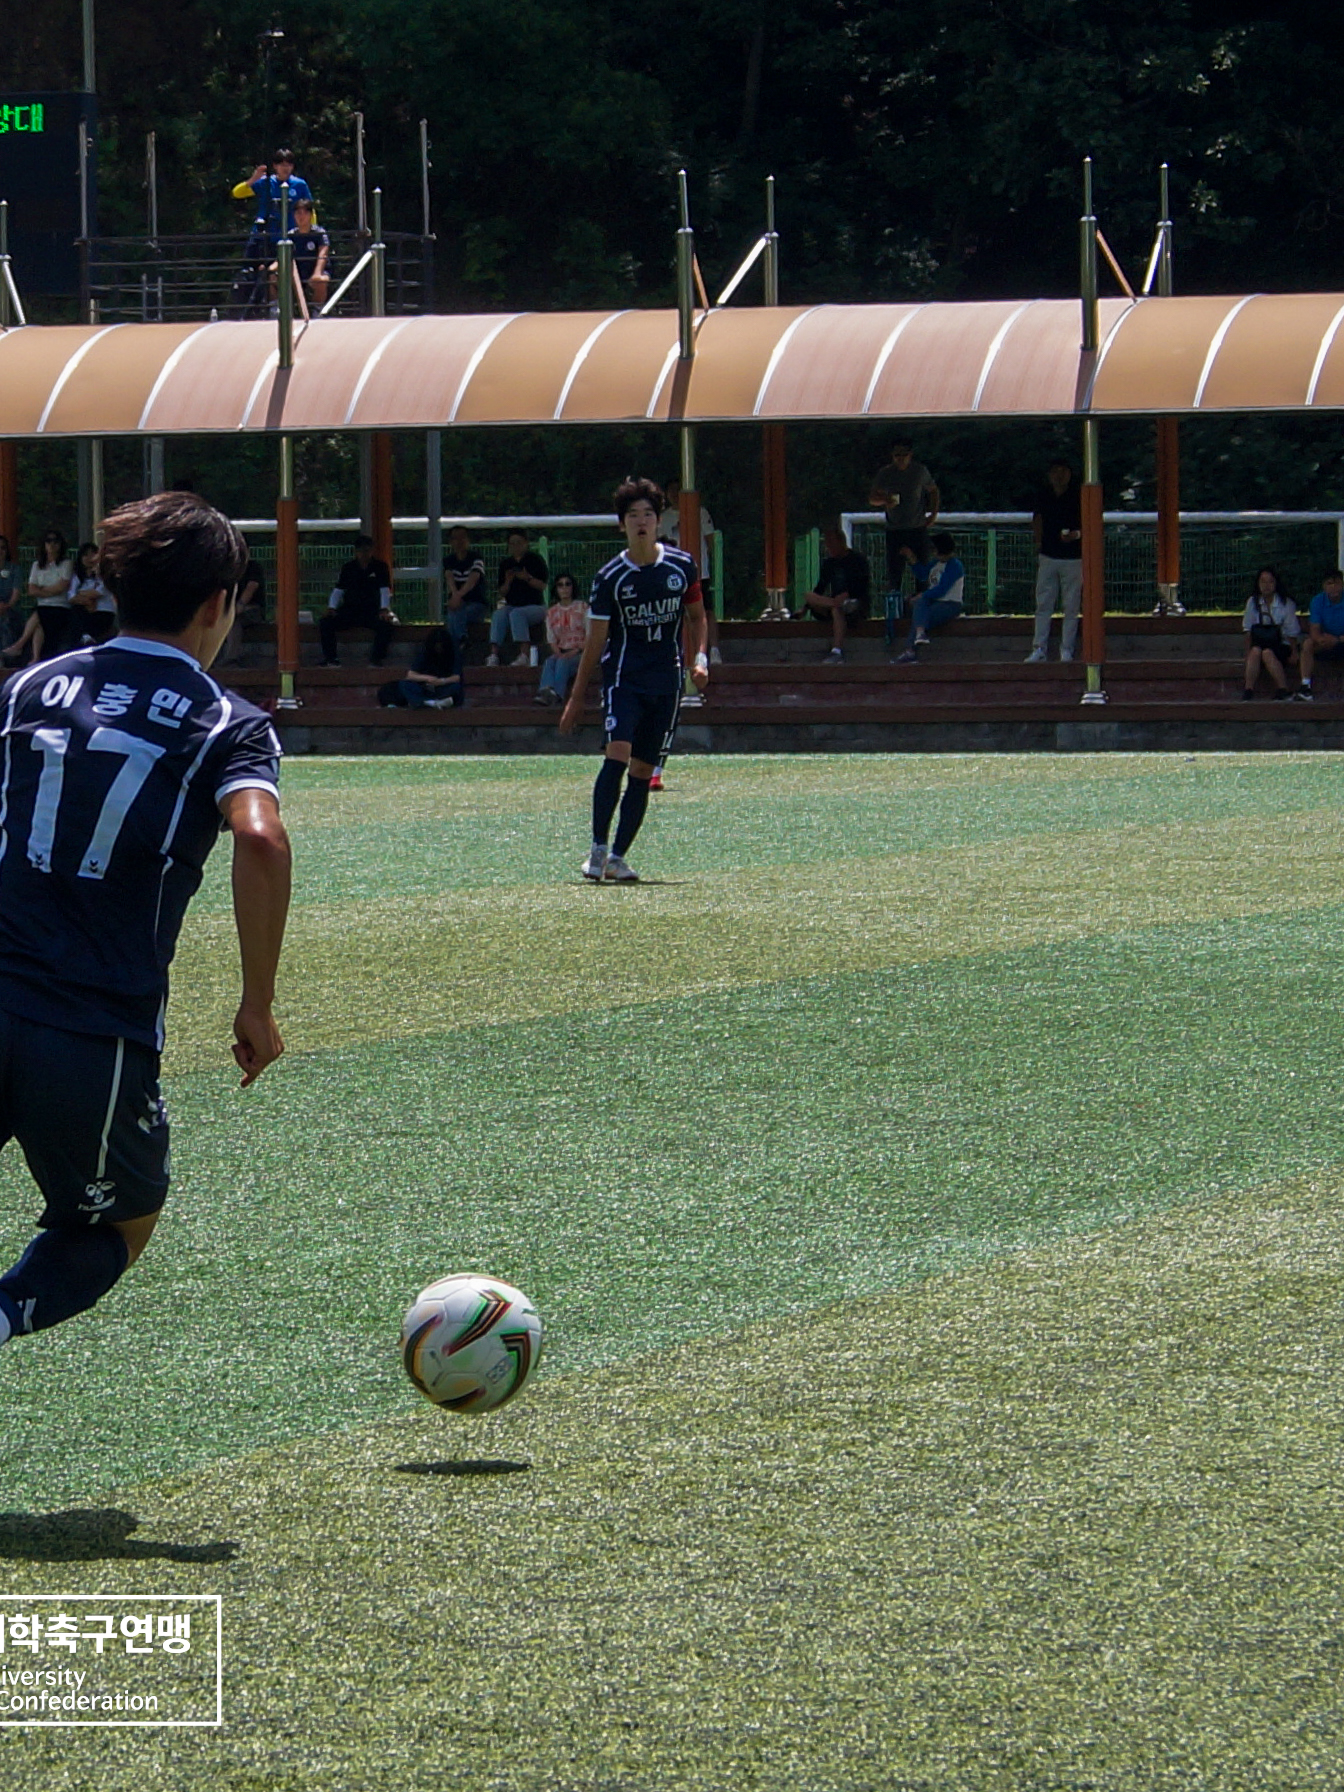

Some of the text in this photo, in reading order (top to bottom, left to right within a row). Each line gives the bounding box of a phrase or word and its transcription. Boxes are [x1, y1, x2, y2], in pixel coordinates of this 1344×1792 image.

[624, 596, 681, 620] CALVIN
[647, 625, 662, 642] 14
[26, 726, 167, 880] 17
